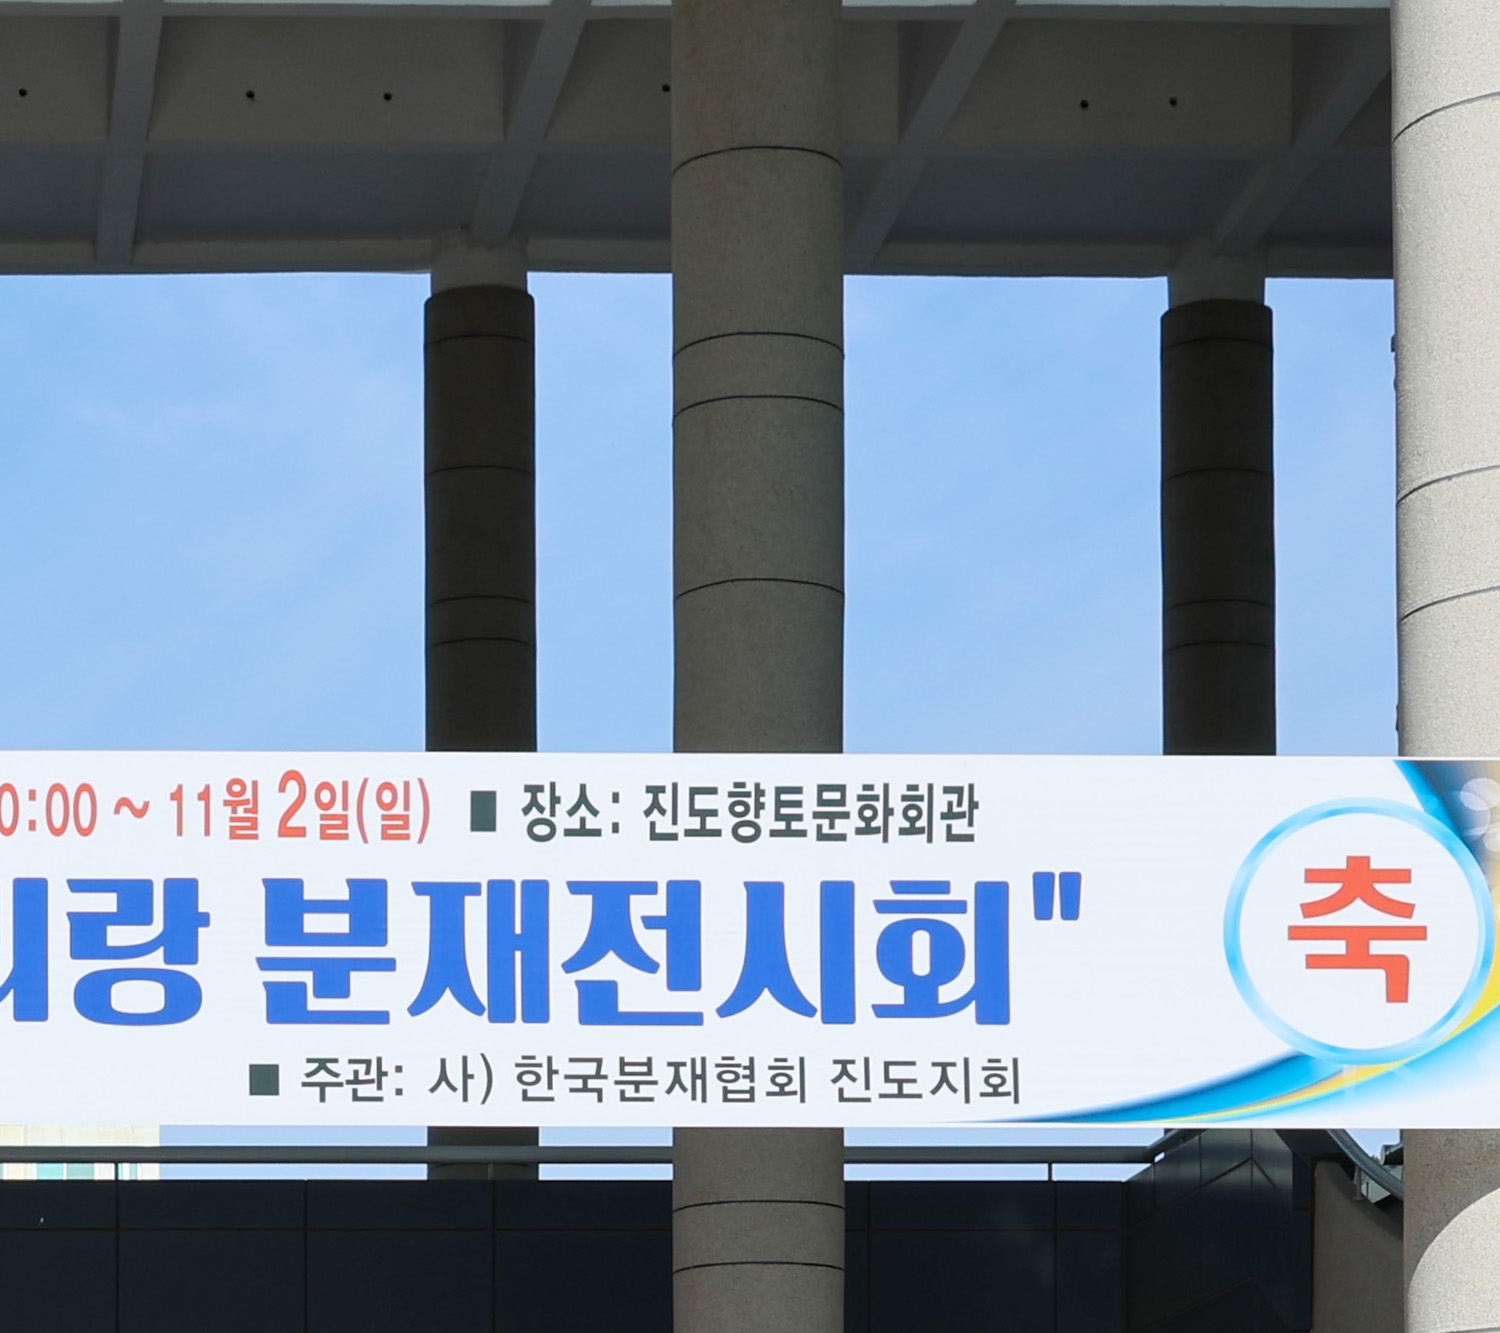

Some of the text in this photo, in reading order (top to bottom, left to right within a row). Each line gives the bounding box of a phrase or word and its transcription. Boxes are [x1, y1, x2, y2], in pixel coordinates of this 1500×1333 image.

[170, 777, 260, 840] 11월
[522, 781, 979, 844] 장소: 진도향토문화회관
[1287, 857, 1428, 1003] 축
[302, 1054, 1020, 1105] 주관: 사) 한국분재협회 진도지회
